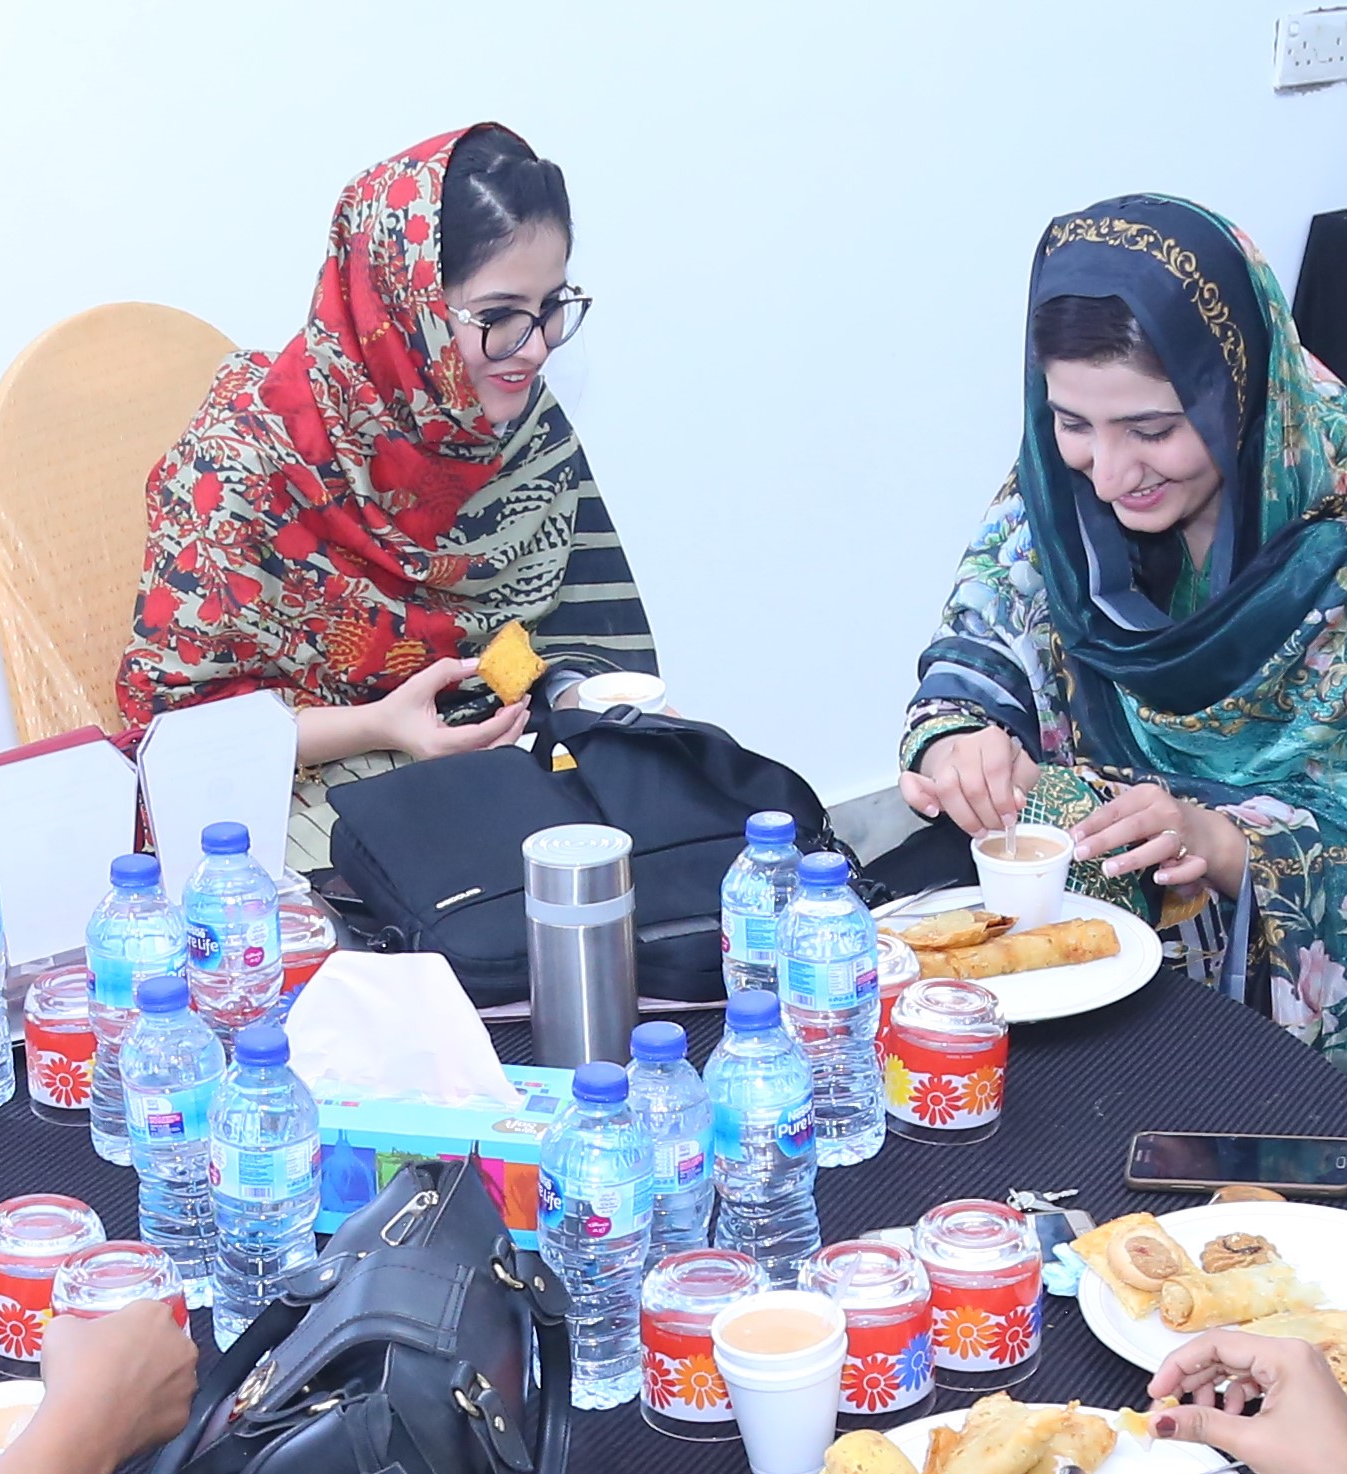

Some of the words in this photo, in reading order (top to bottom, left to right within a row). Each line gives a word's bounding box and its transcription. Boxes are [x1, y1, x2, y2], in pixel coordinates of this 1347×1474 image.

[197, 938, 219, 957] Life
[778, 1120, 807, 1139] Pure
[543, 1190, 562, 1211] Life
